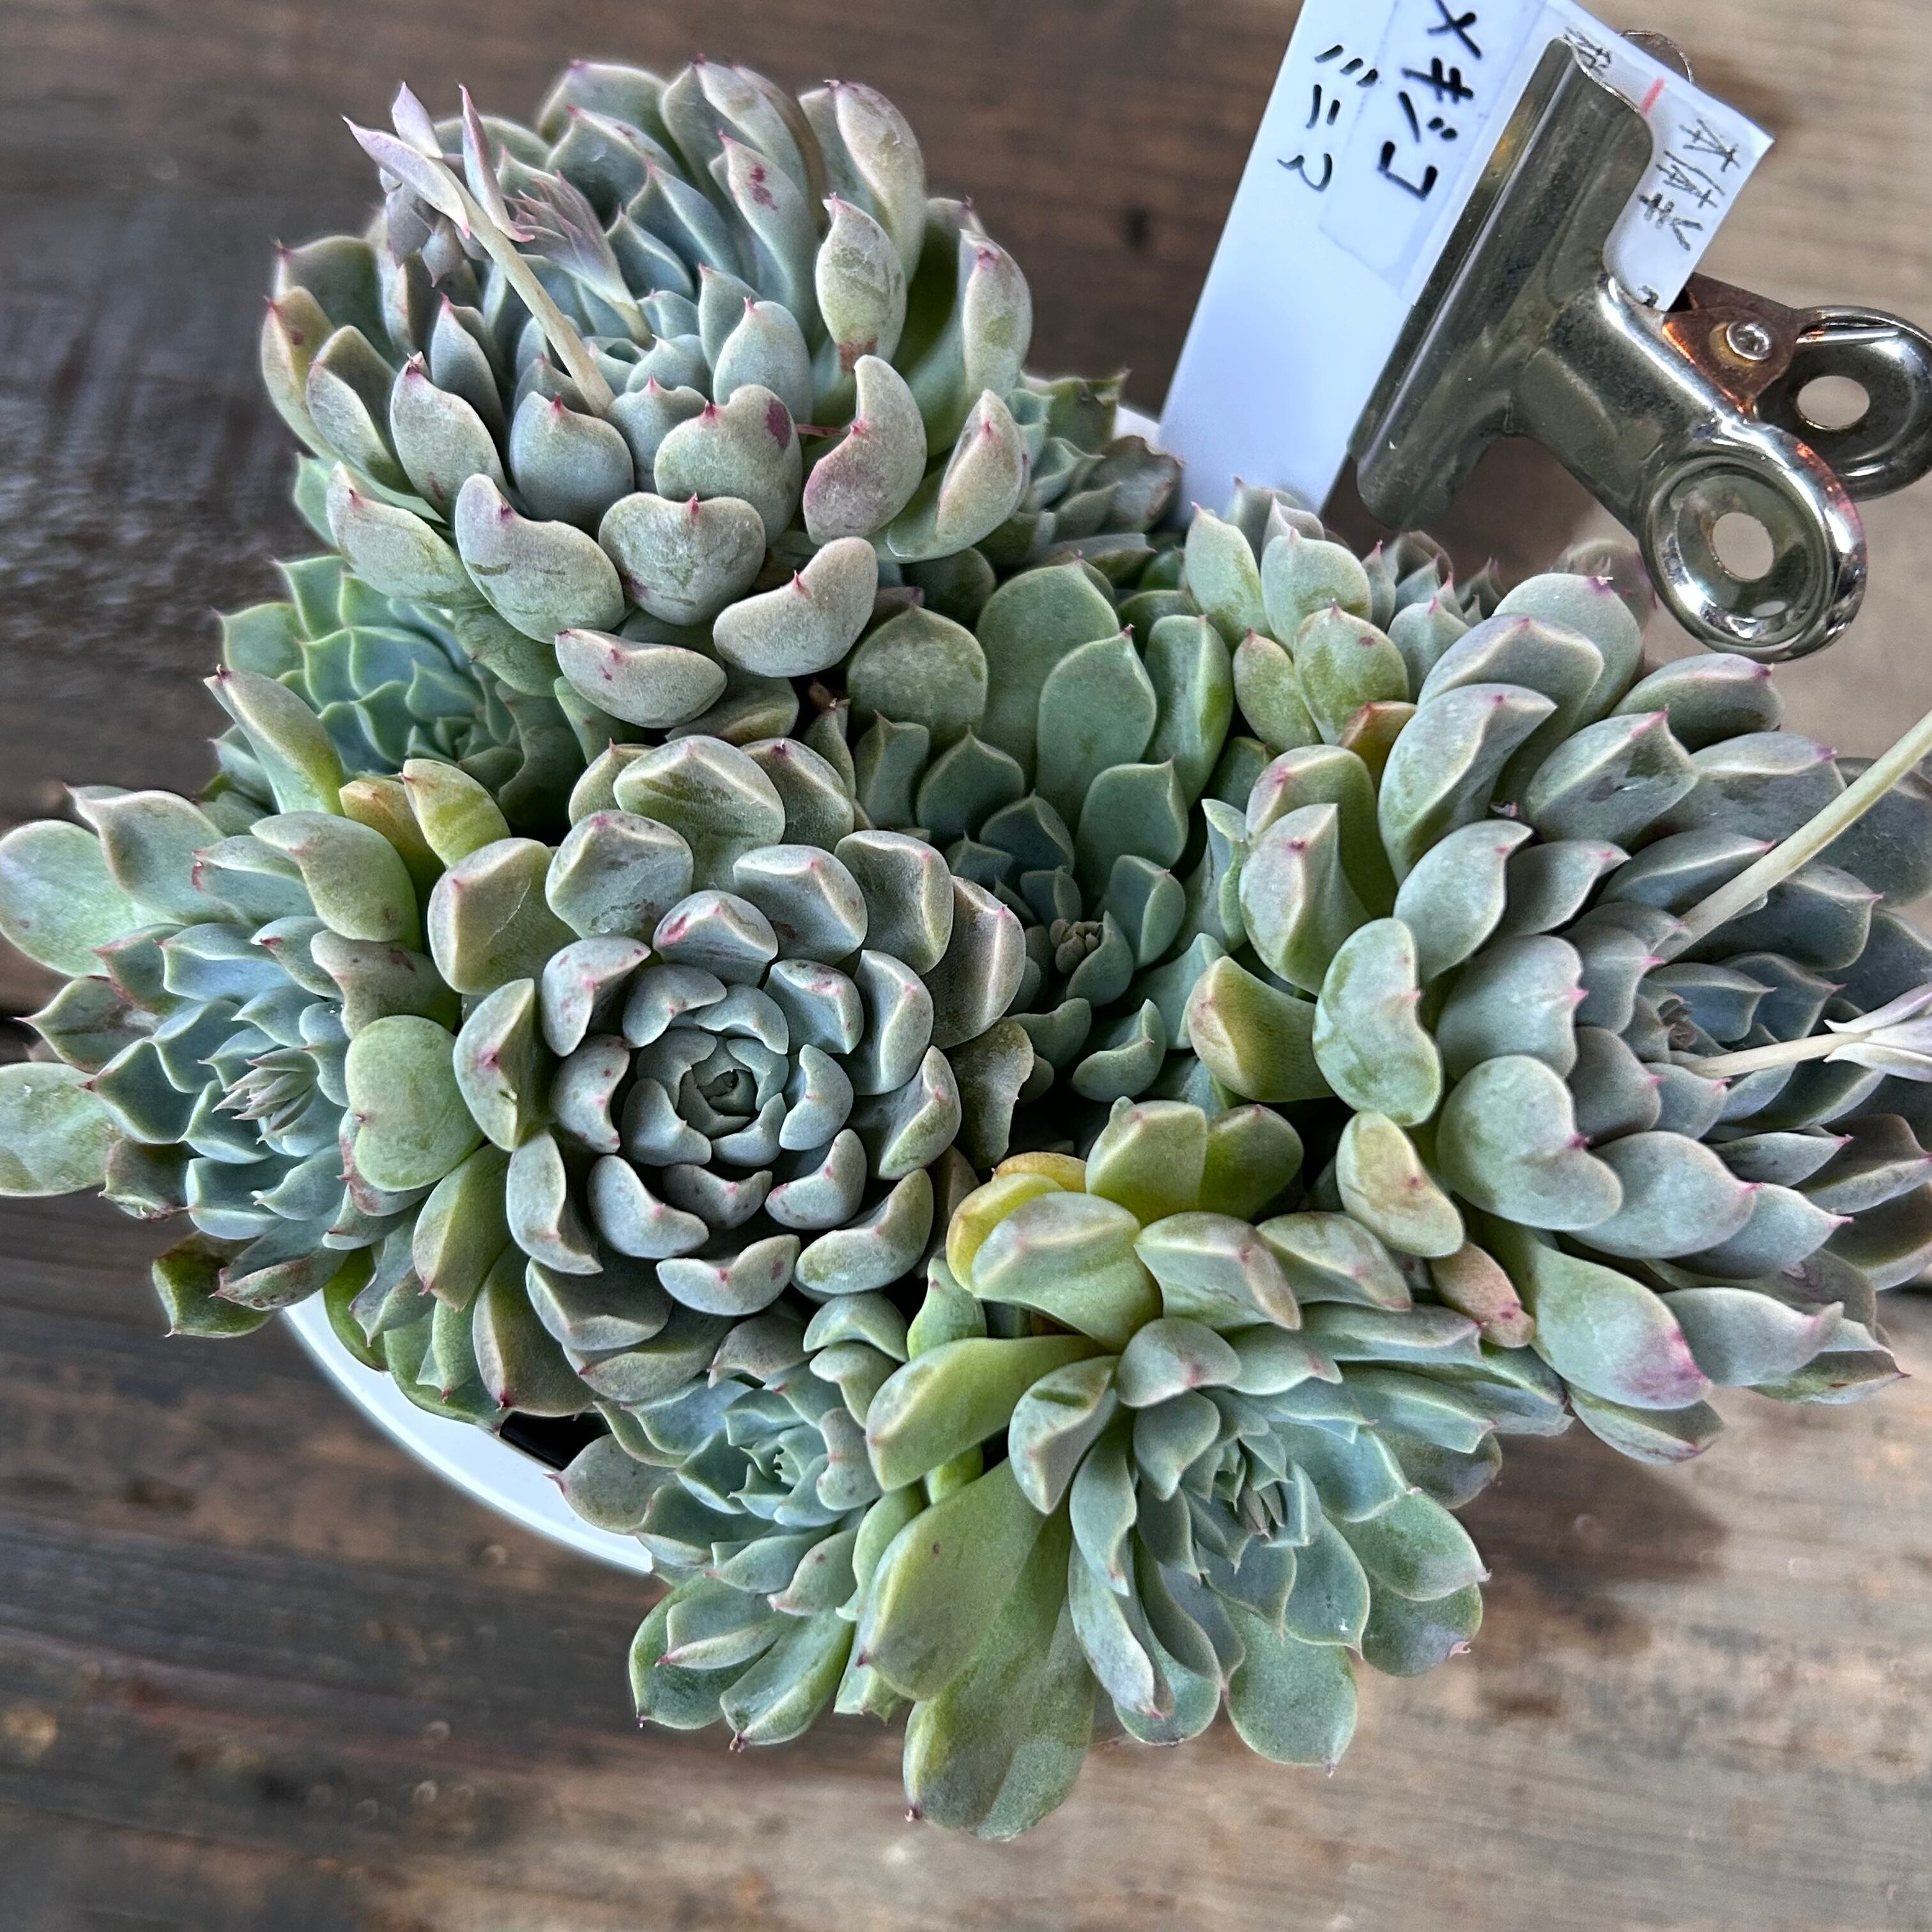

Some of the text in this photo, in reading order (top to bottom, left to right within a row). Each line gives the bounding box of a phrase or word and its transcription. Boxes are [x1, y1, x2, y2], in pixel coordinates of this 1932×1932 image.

[1277, 44, 1379, 193] ミニマ
[1377, 0, 1482, 201] メキシコ
